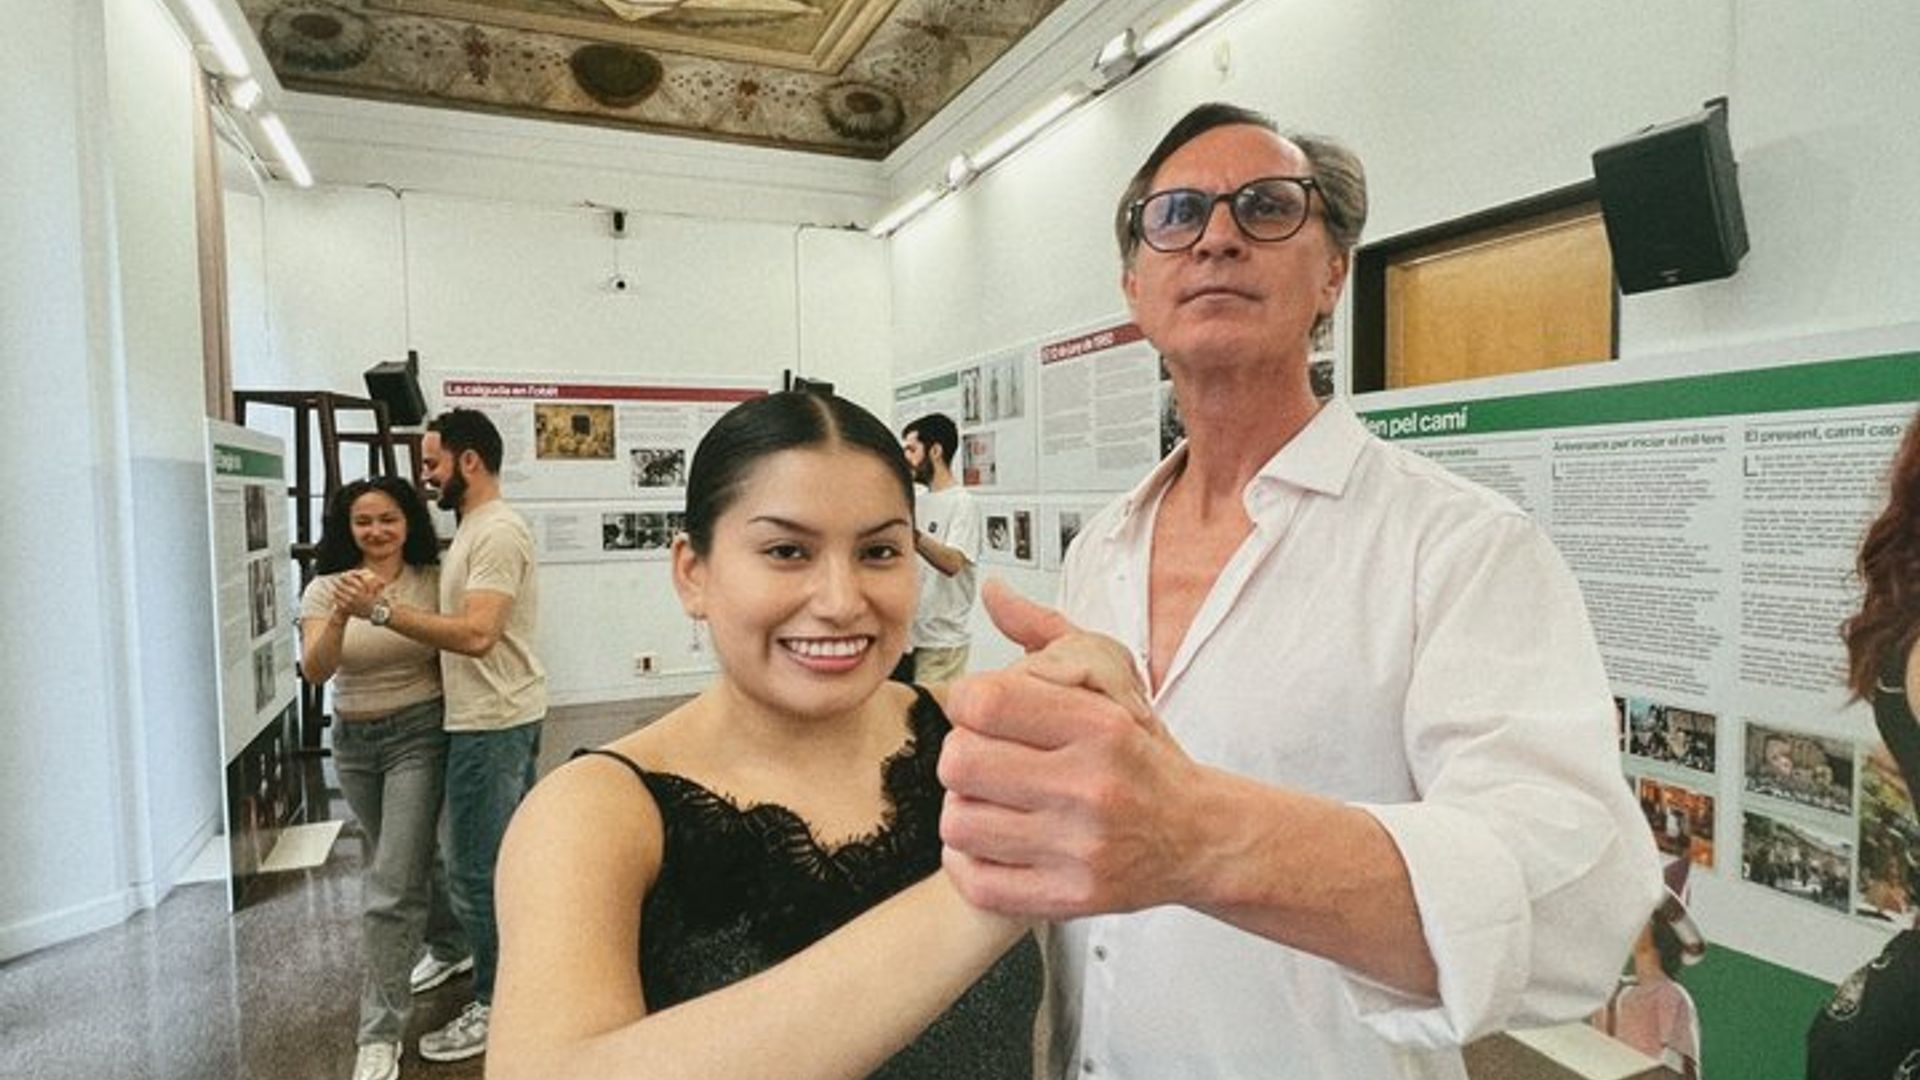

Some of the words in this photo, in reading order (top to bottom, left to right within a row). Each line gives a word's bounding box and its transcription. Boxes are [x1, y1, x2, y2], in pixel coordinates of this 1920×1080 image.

[448, 385, 462, 395] La
[1389, 411, 1418, 438] pel
[1419, 406, 1468, 432] camí
[1744, 429, 1758, 443] El
[1760, 427, 1823, 443] present,
[1867, 425, 1901, 439] cap
